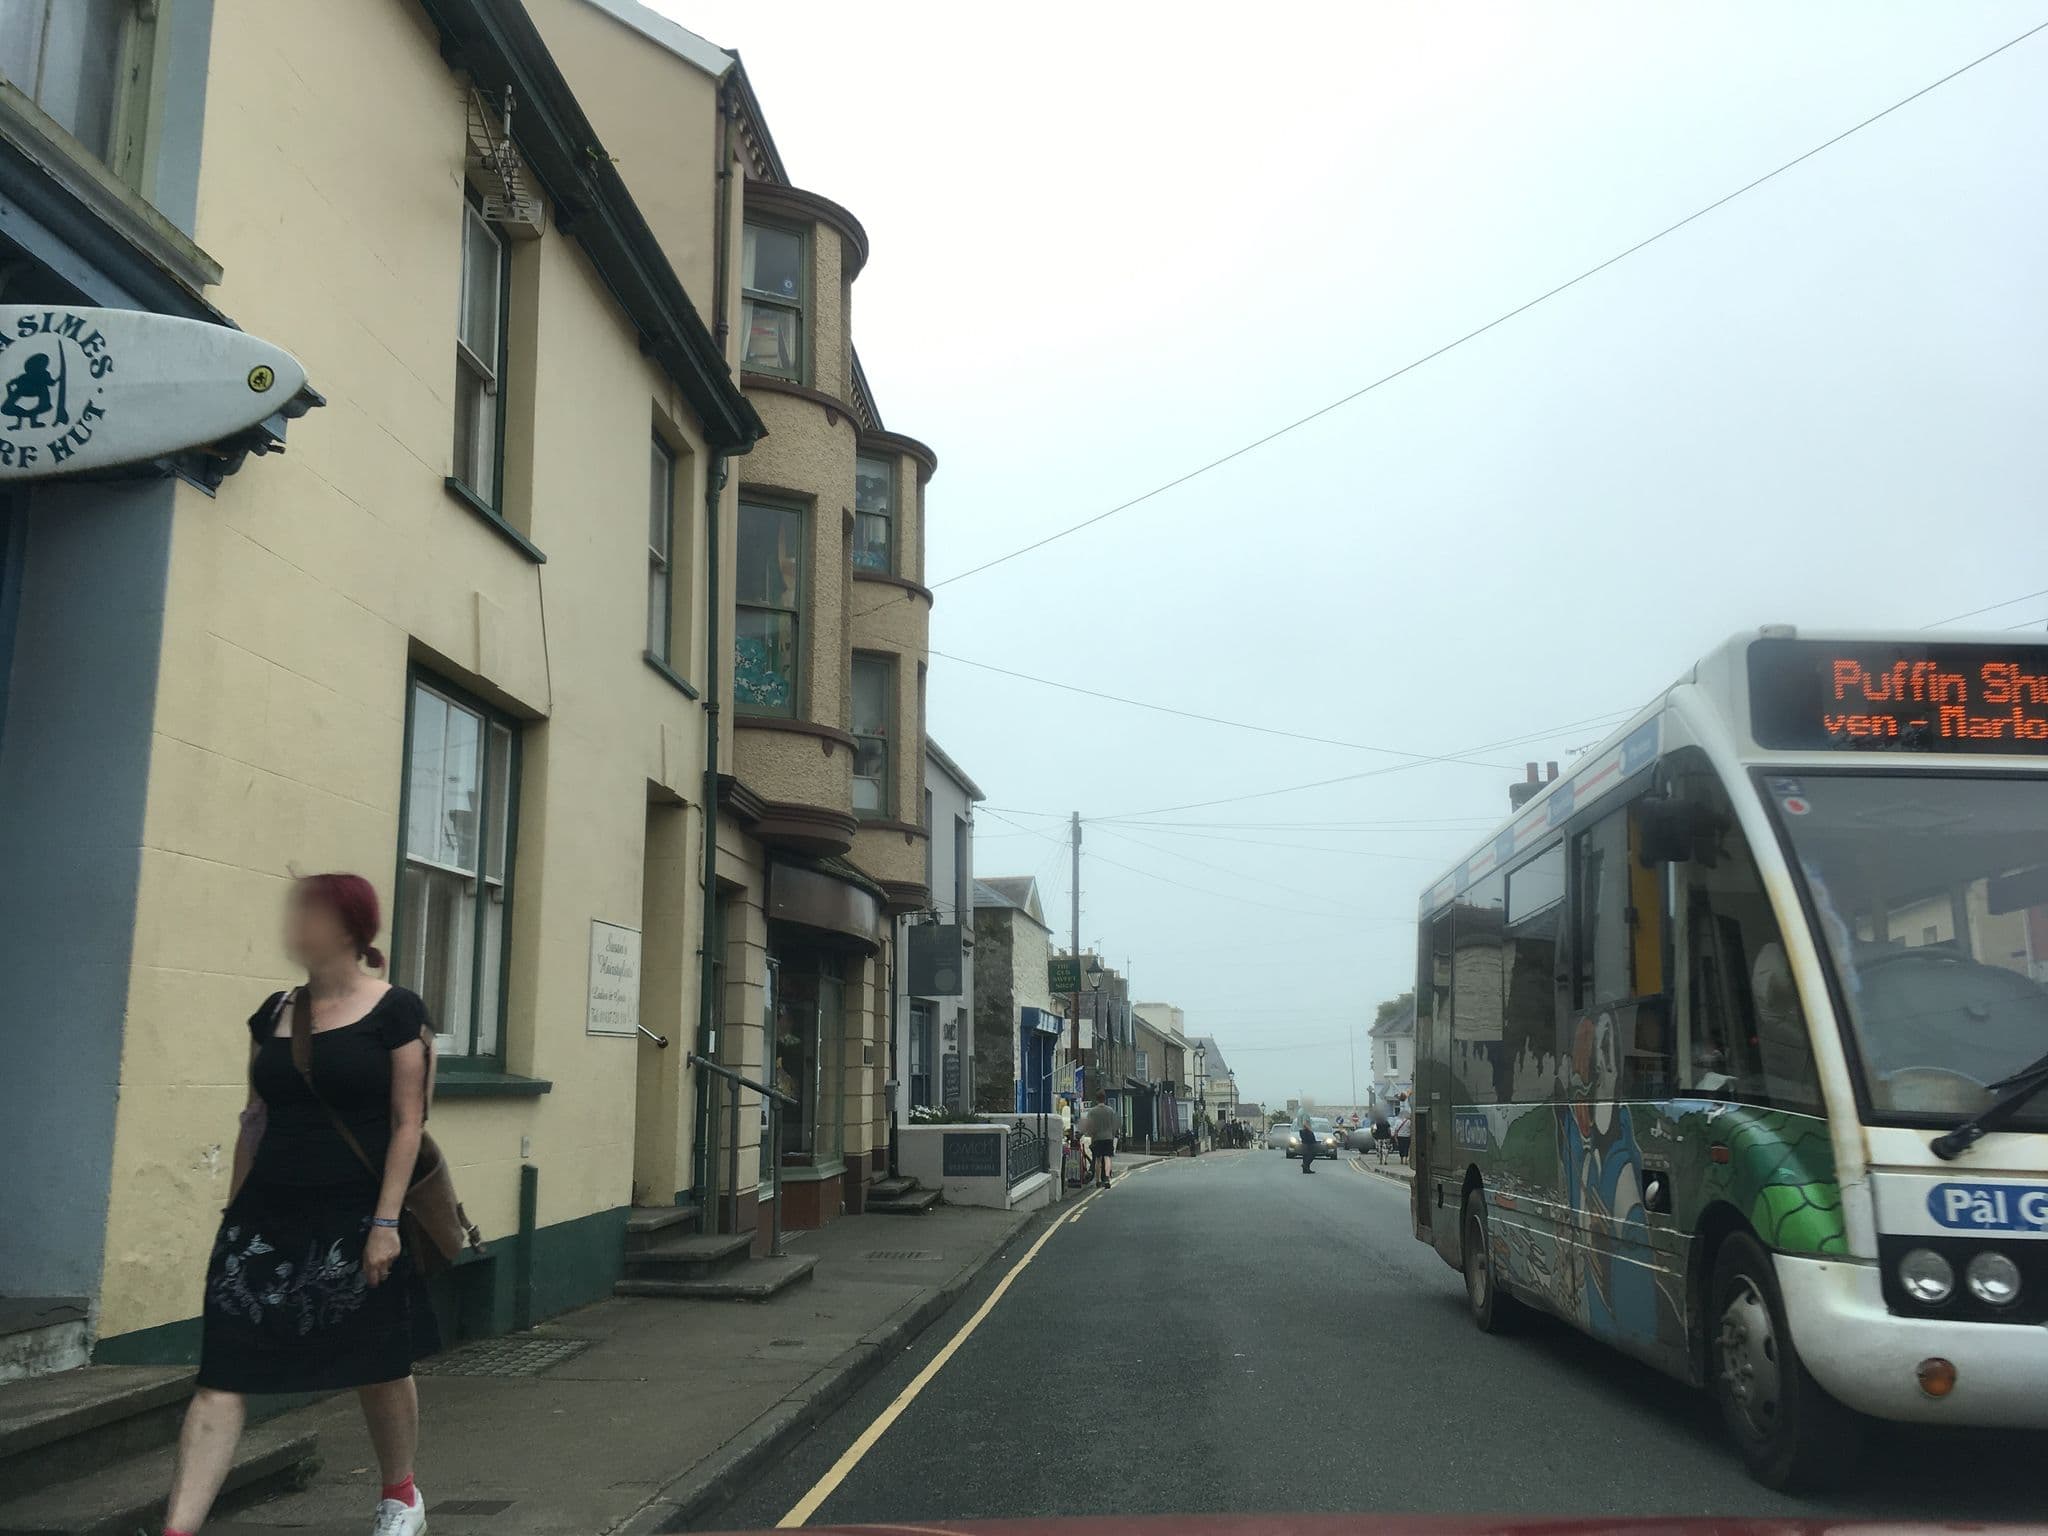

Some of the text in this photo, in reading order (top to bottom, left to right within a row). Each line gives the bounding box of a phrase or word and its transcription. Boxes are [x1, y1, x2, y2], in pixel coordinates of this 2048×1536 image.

[17, 312, 113, 379] SIMES
[47, 399, 105, 464] HUT
[1833, 660, 1967, 702] Puffin
[1823, 714, 1898, 736] ven
[1943, 1189, 2048, 1225] Pâl G
